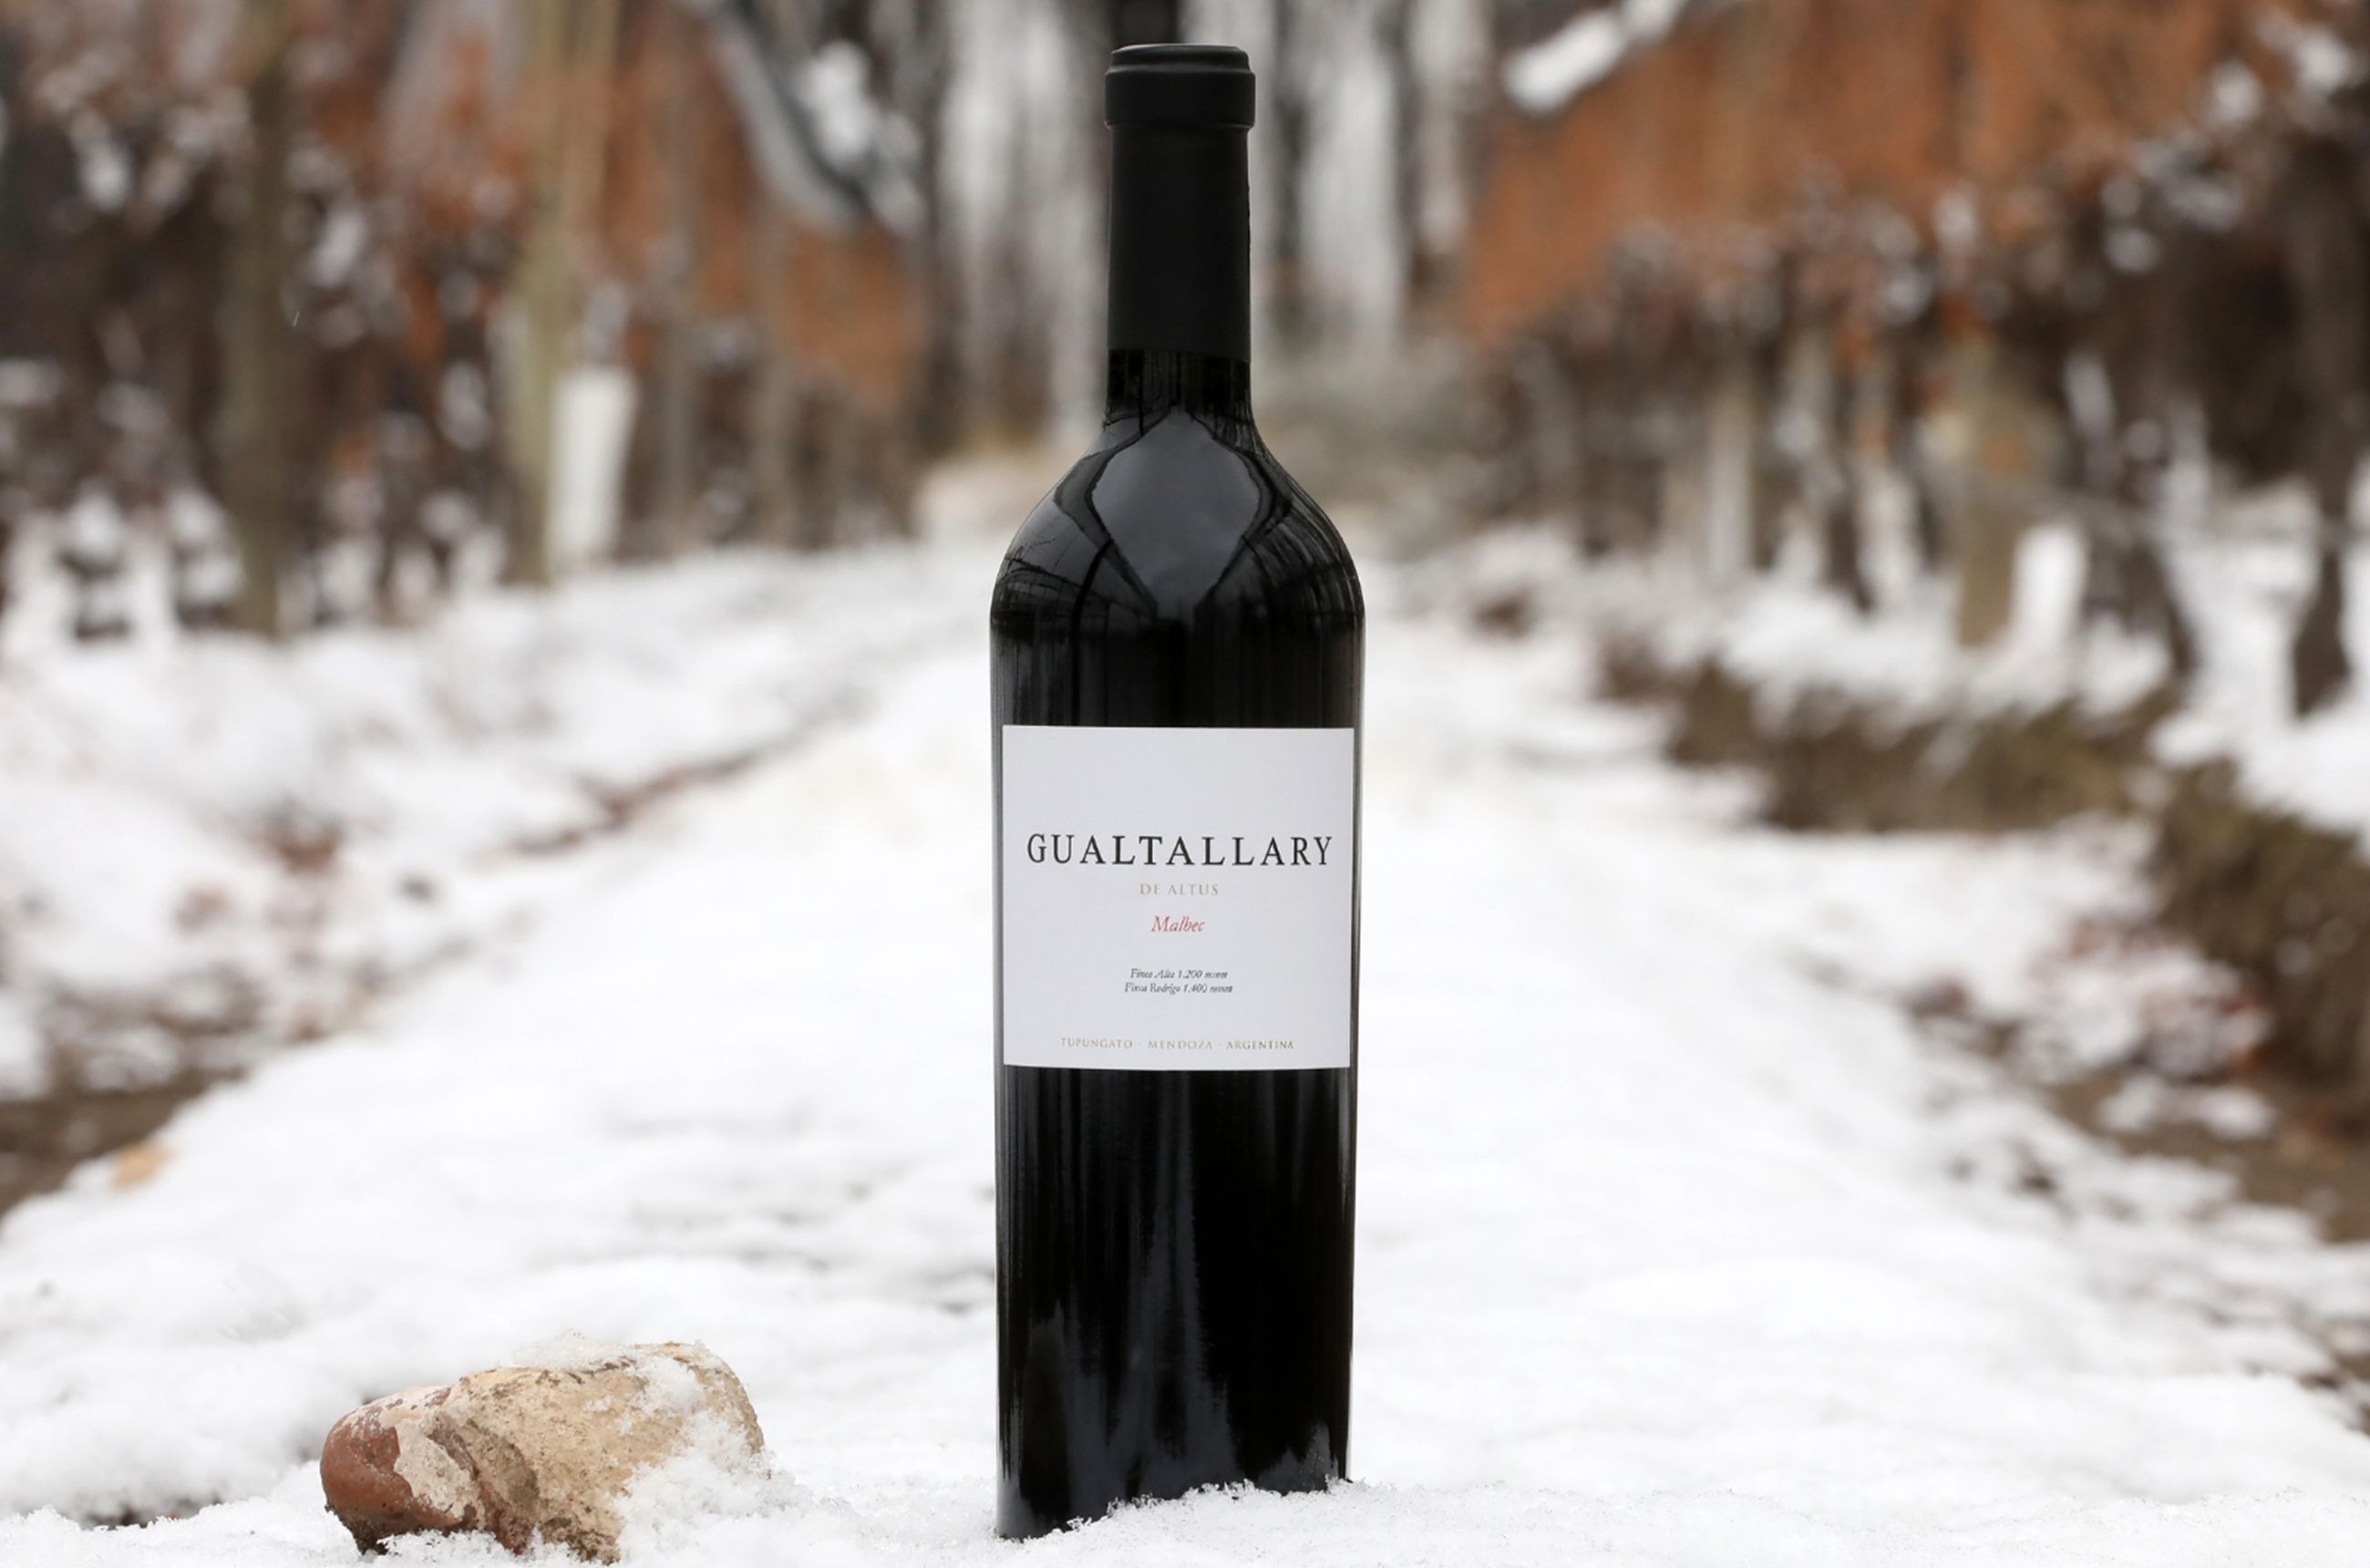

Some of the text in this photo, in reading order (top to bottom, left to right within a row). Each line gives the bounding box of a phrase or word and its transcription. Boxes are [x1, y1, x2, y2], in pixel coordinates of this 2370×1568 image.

[1026, 833, 1333, 866] GUALTALLARY
[1139, 882, 1220, 896] DE ALTUS
[1150, 915, 1206, 933] Malbec
[1129, 968, 1153, 979] Finca
[1177, 969, 1203, 979] 1.200
[1124, 982, 1149, 994] Finca
[1149, 982, 1181, 996] Rodrigo
[1182, 983, 1209, 994] 1.400
[1060, 1037, 1295, 1050] TUPUNGATO MENDOZA ARGENTINA
